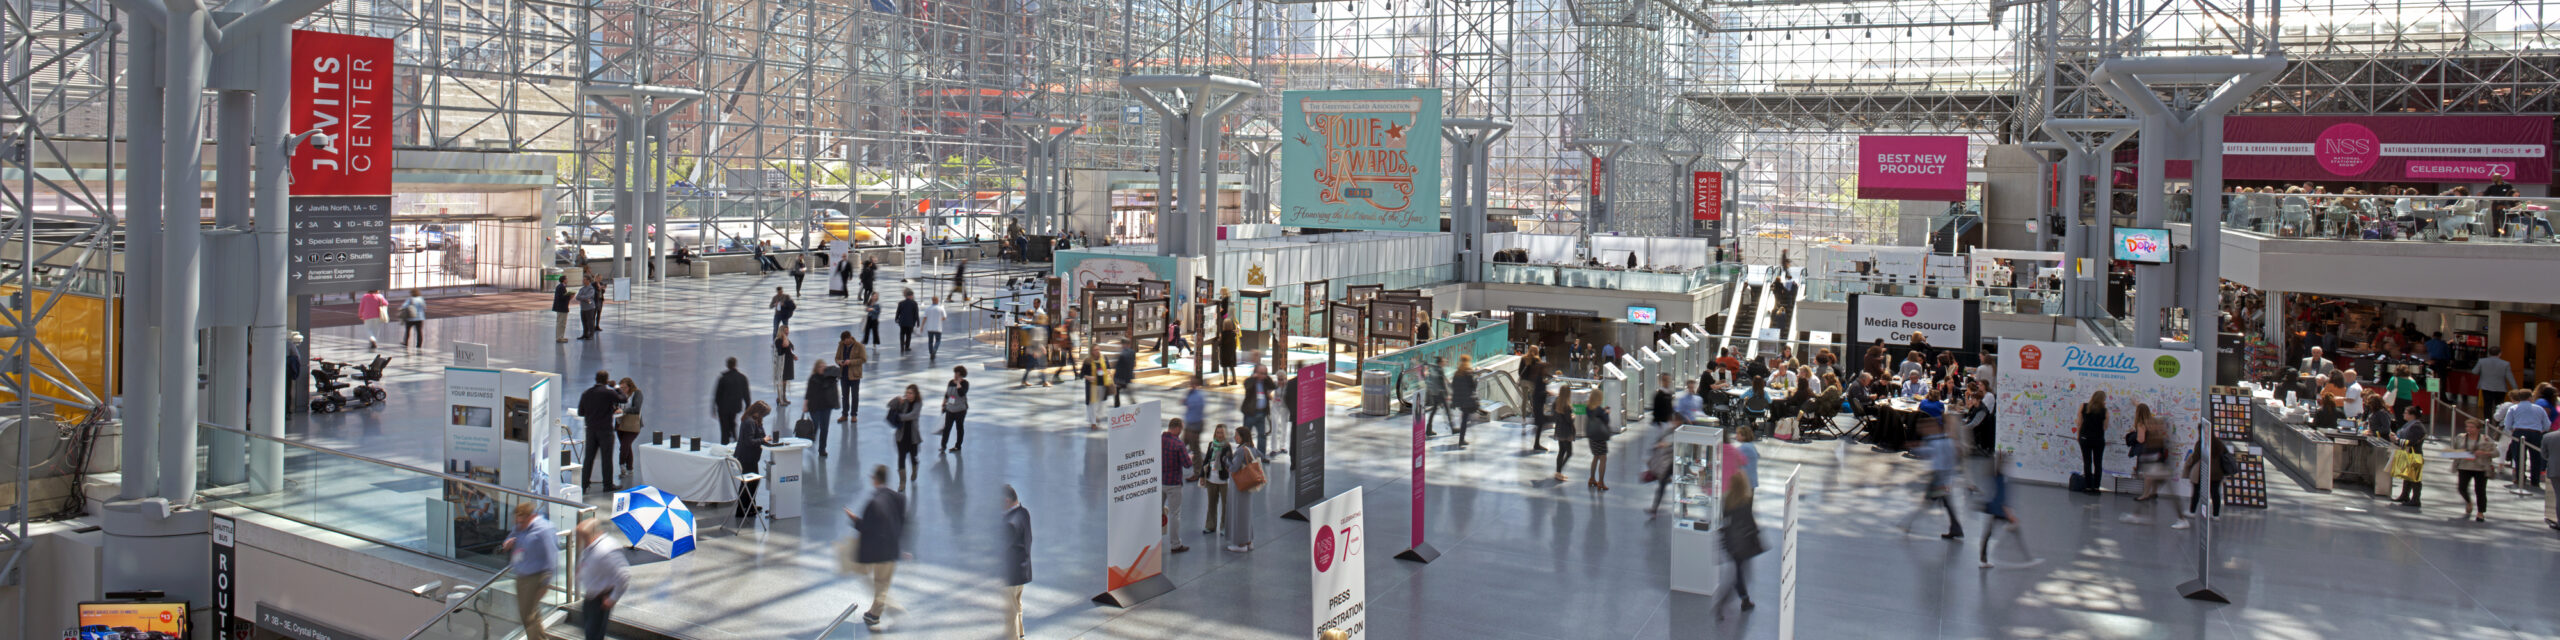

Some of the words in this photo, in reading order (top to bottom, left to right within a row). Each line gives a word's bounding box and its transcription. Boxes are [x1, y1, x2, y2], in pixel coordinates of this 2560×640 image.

[351, 58, 373, 172] CENTER
[2251, 145, 2278, 153] CREATIVE
[2325, 138, 2370, 154] NSS
[2383, 146, 2482, 154] NATIONALSTATIONERYSHOW.COM
[1877, 153, 1911, 164] BEST
[1914, 154, 1947, 164] NEW
[1879, 163, 1945, 174] PRODUCT
[2411, 165, 2486, 174] CELEBRATING
[2486, 163, 2510, 177] 70
[1698, 177, 1708, 214] JAVITS
[1709, 177, 1718, 214] CENTER
[308, 204, 329, 212] Javits
[308, 221, 319, 229] 3A
[1700, 219, 1713, 230] 1E
[308, 238, 334, 246] Special
[2126, 238, 2158, 253] DORA
[1864, 317, 1898, 328] Media
[1901, 319, 1956, 332] Resource
[1890, 331, 1929, 341] Cenr
[2062, 346, 2140, 373] Pirasta
[1125, 449, 1146, 460] SURTEX
[1116, 457, 1156, 472] REGISTRATION
[1126, 468, 1152, 480] LOCATED
[1113, 480, 1149, 494] DOWNSTAIRS
[1149, 476, 1158, 484] ON
[1114, 495, 1125, 504] THE
[1125, 486, 1158, 501] CONCOURSE
[214, 522, 233, 534] SHUTTLE
[218, 533, 228, 543] BUS
[1329, 589, 1351, 611] PRESS
[271, 615, 279, 626] 3B
[292, 622, 312, 637] Crystal
[1317, 601, 1364, 639] REGISTRATION
[1353, 620, 1364, 636] ON
